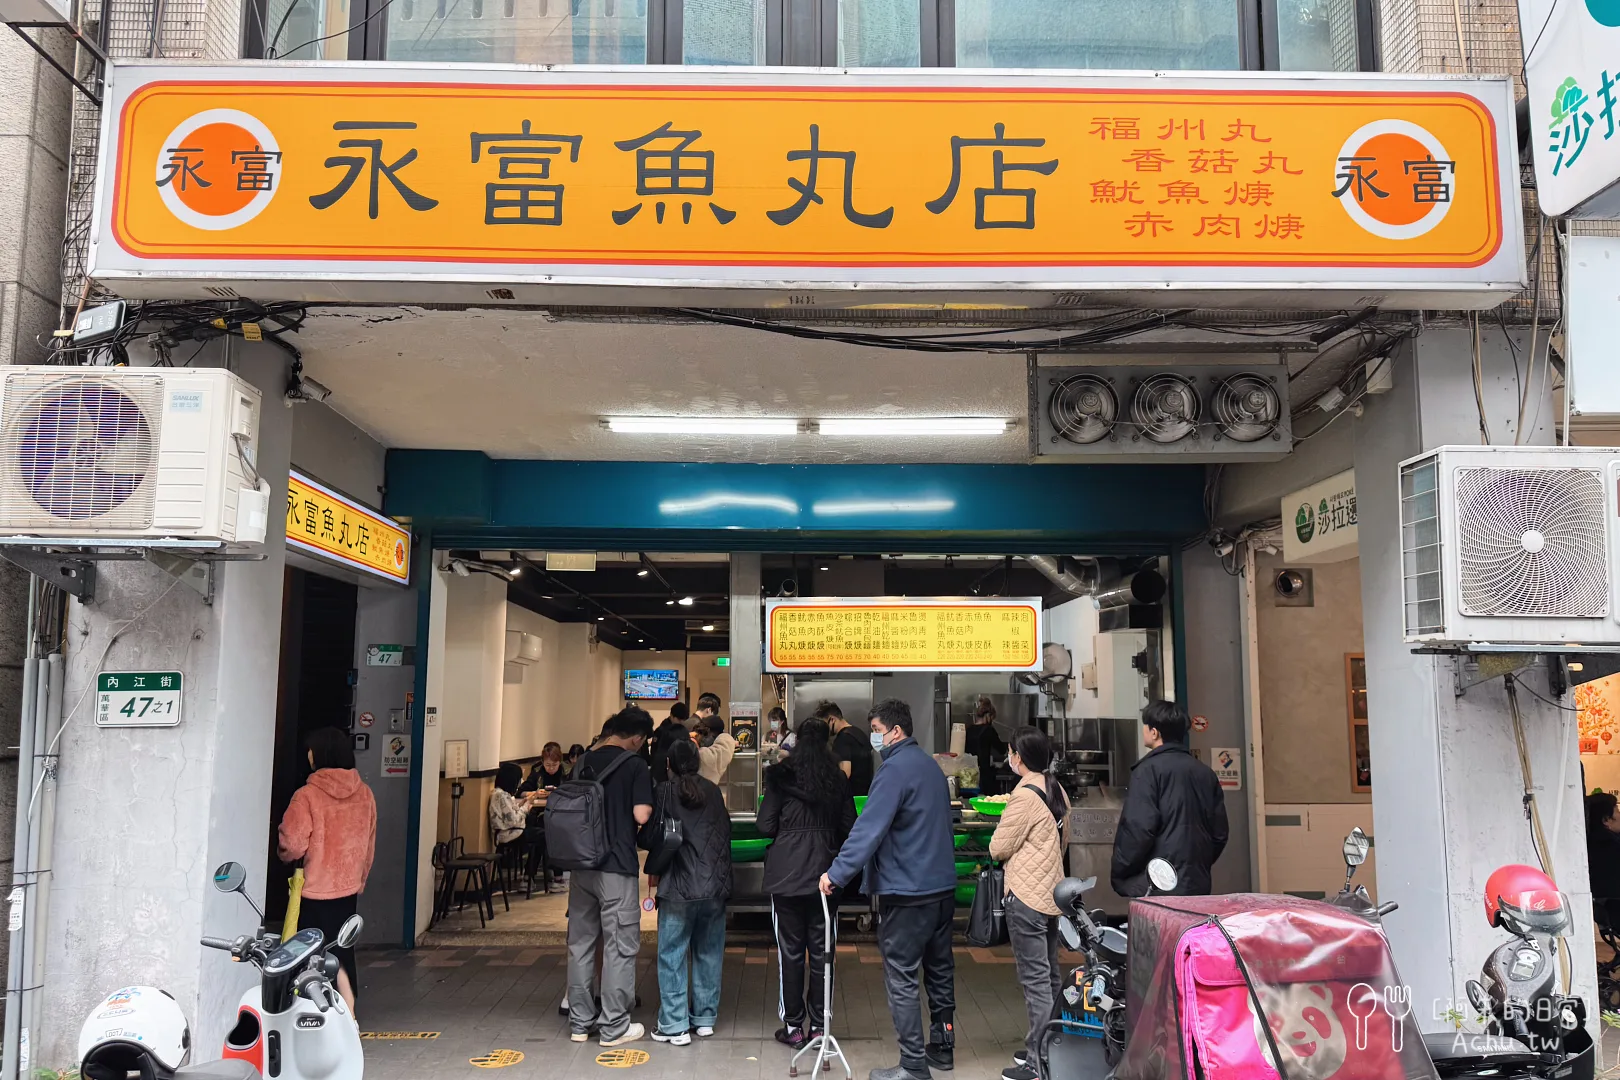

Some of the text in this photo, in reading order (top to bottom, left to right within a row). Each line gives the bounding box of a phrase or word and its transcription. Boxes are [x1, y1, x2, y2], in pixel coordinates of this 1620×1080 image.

[1088, 117, 1272, 142] 福州丸
[155, 145, 283, 191] 永富
[308, 119, 1059, 231] 永富魚丸店
[1122, 148, 1304, 175] 香菇丸
[1331, 154, 1456, 203] 永富
[286, 488, 370, 556] 永富魚丸店
[107, 676, 172, 688] 內江街
